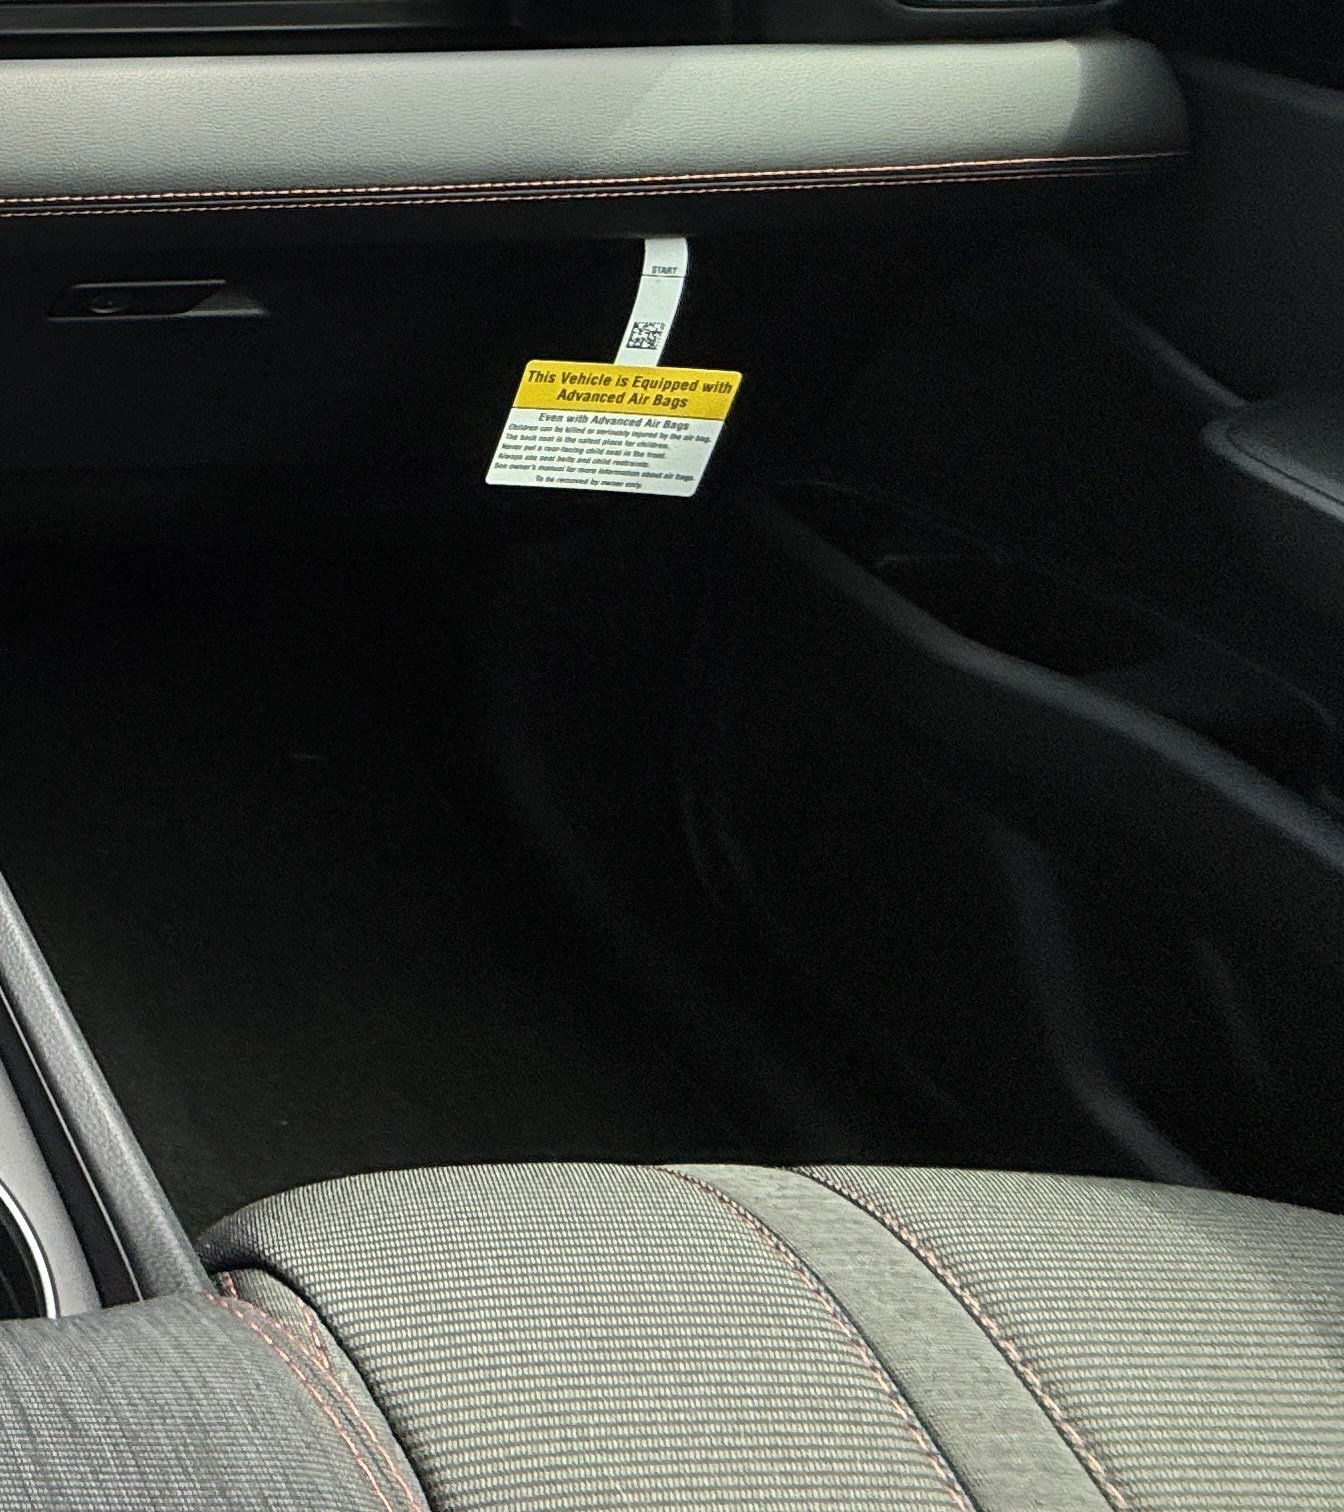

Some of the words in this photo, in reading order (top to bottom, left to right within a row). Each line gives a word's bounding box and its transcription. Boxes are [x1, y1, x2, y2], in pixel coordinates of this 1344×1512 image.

[527, 370, 557, 384] This
[561, 371, 612, 387] Vehicle
[614, 373, 629, 387] is
[632, 375, 700, 392] Equipped
[702, 380, 733, 395] with
[556, 388, 626, 405] Advanced
[626, 391, 649, 406] Air
[651, 393, 689, 410] Bags
[538, 412, 563, 422] Even
[566, 414, 589, 424] with
[590, 415, 643, 427] Advanced
[643, 418, 662, 429] Air
[662, 419, 690, 432] Bags
